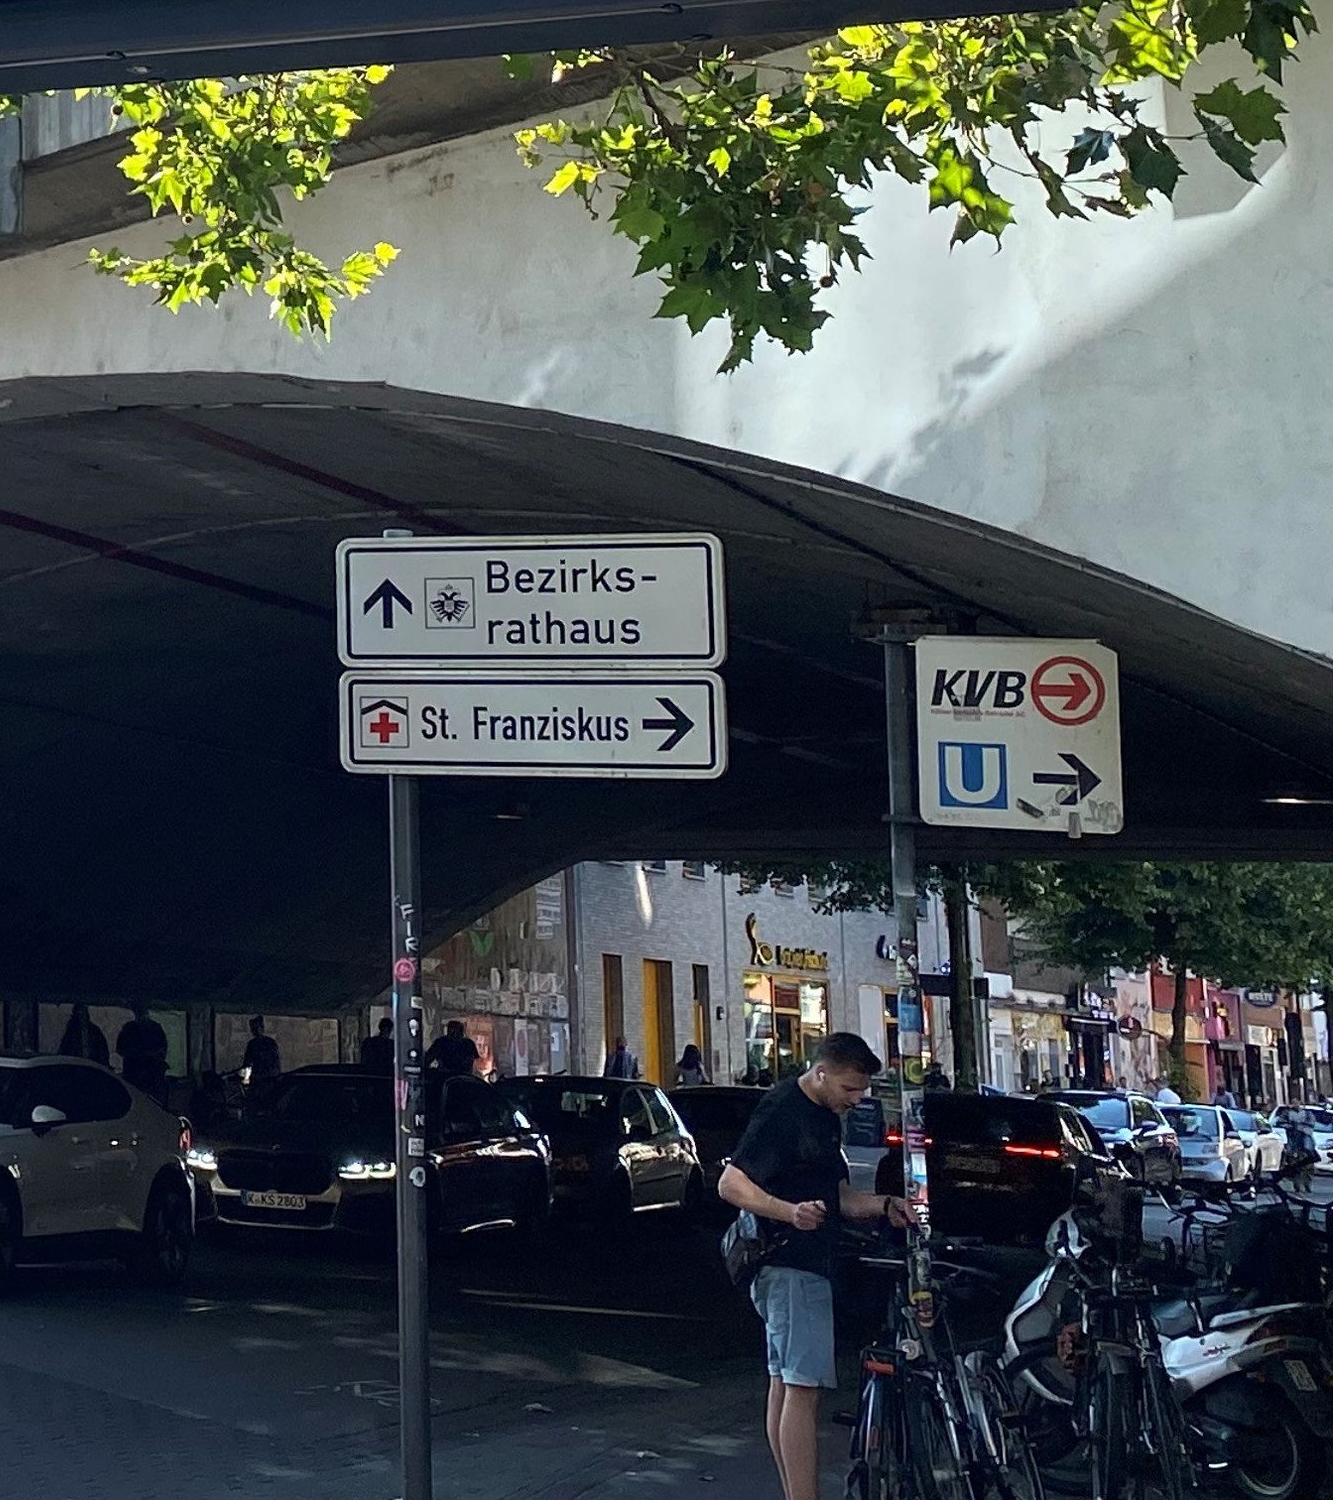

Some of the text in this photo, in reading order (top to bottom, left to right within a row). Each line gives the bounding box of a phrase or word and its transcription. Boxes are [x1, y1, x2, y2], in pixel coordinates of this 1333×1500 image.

[485, 559, 658, 596] Bezirks-
[486, 610, 642, 647] rathaus
[931, 669, 1027, 709] KVB
[420, 706, 630, 744] St. Franziskus
[945, 746, 1001, 804] U
